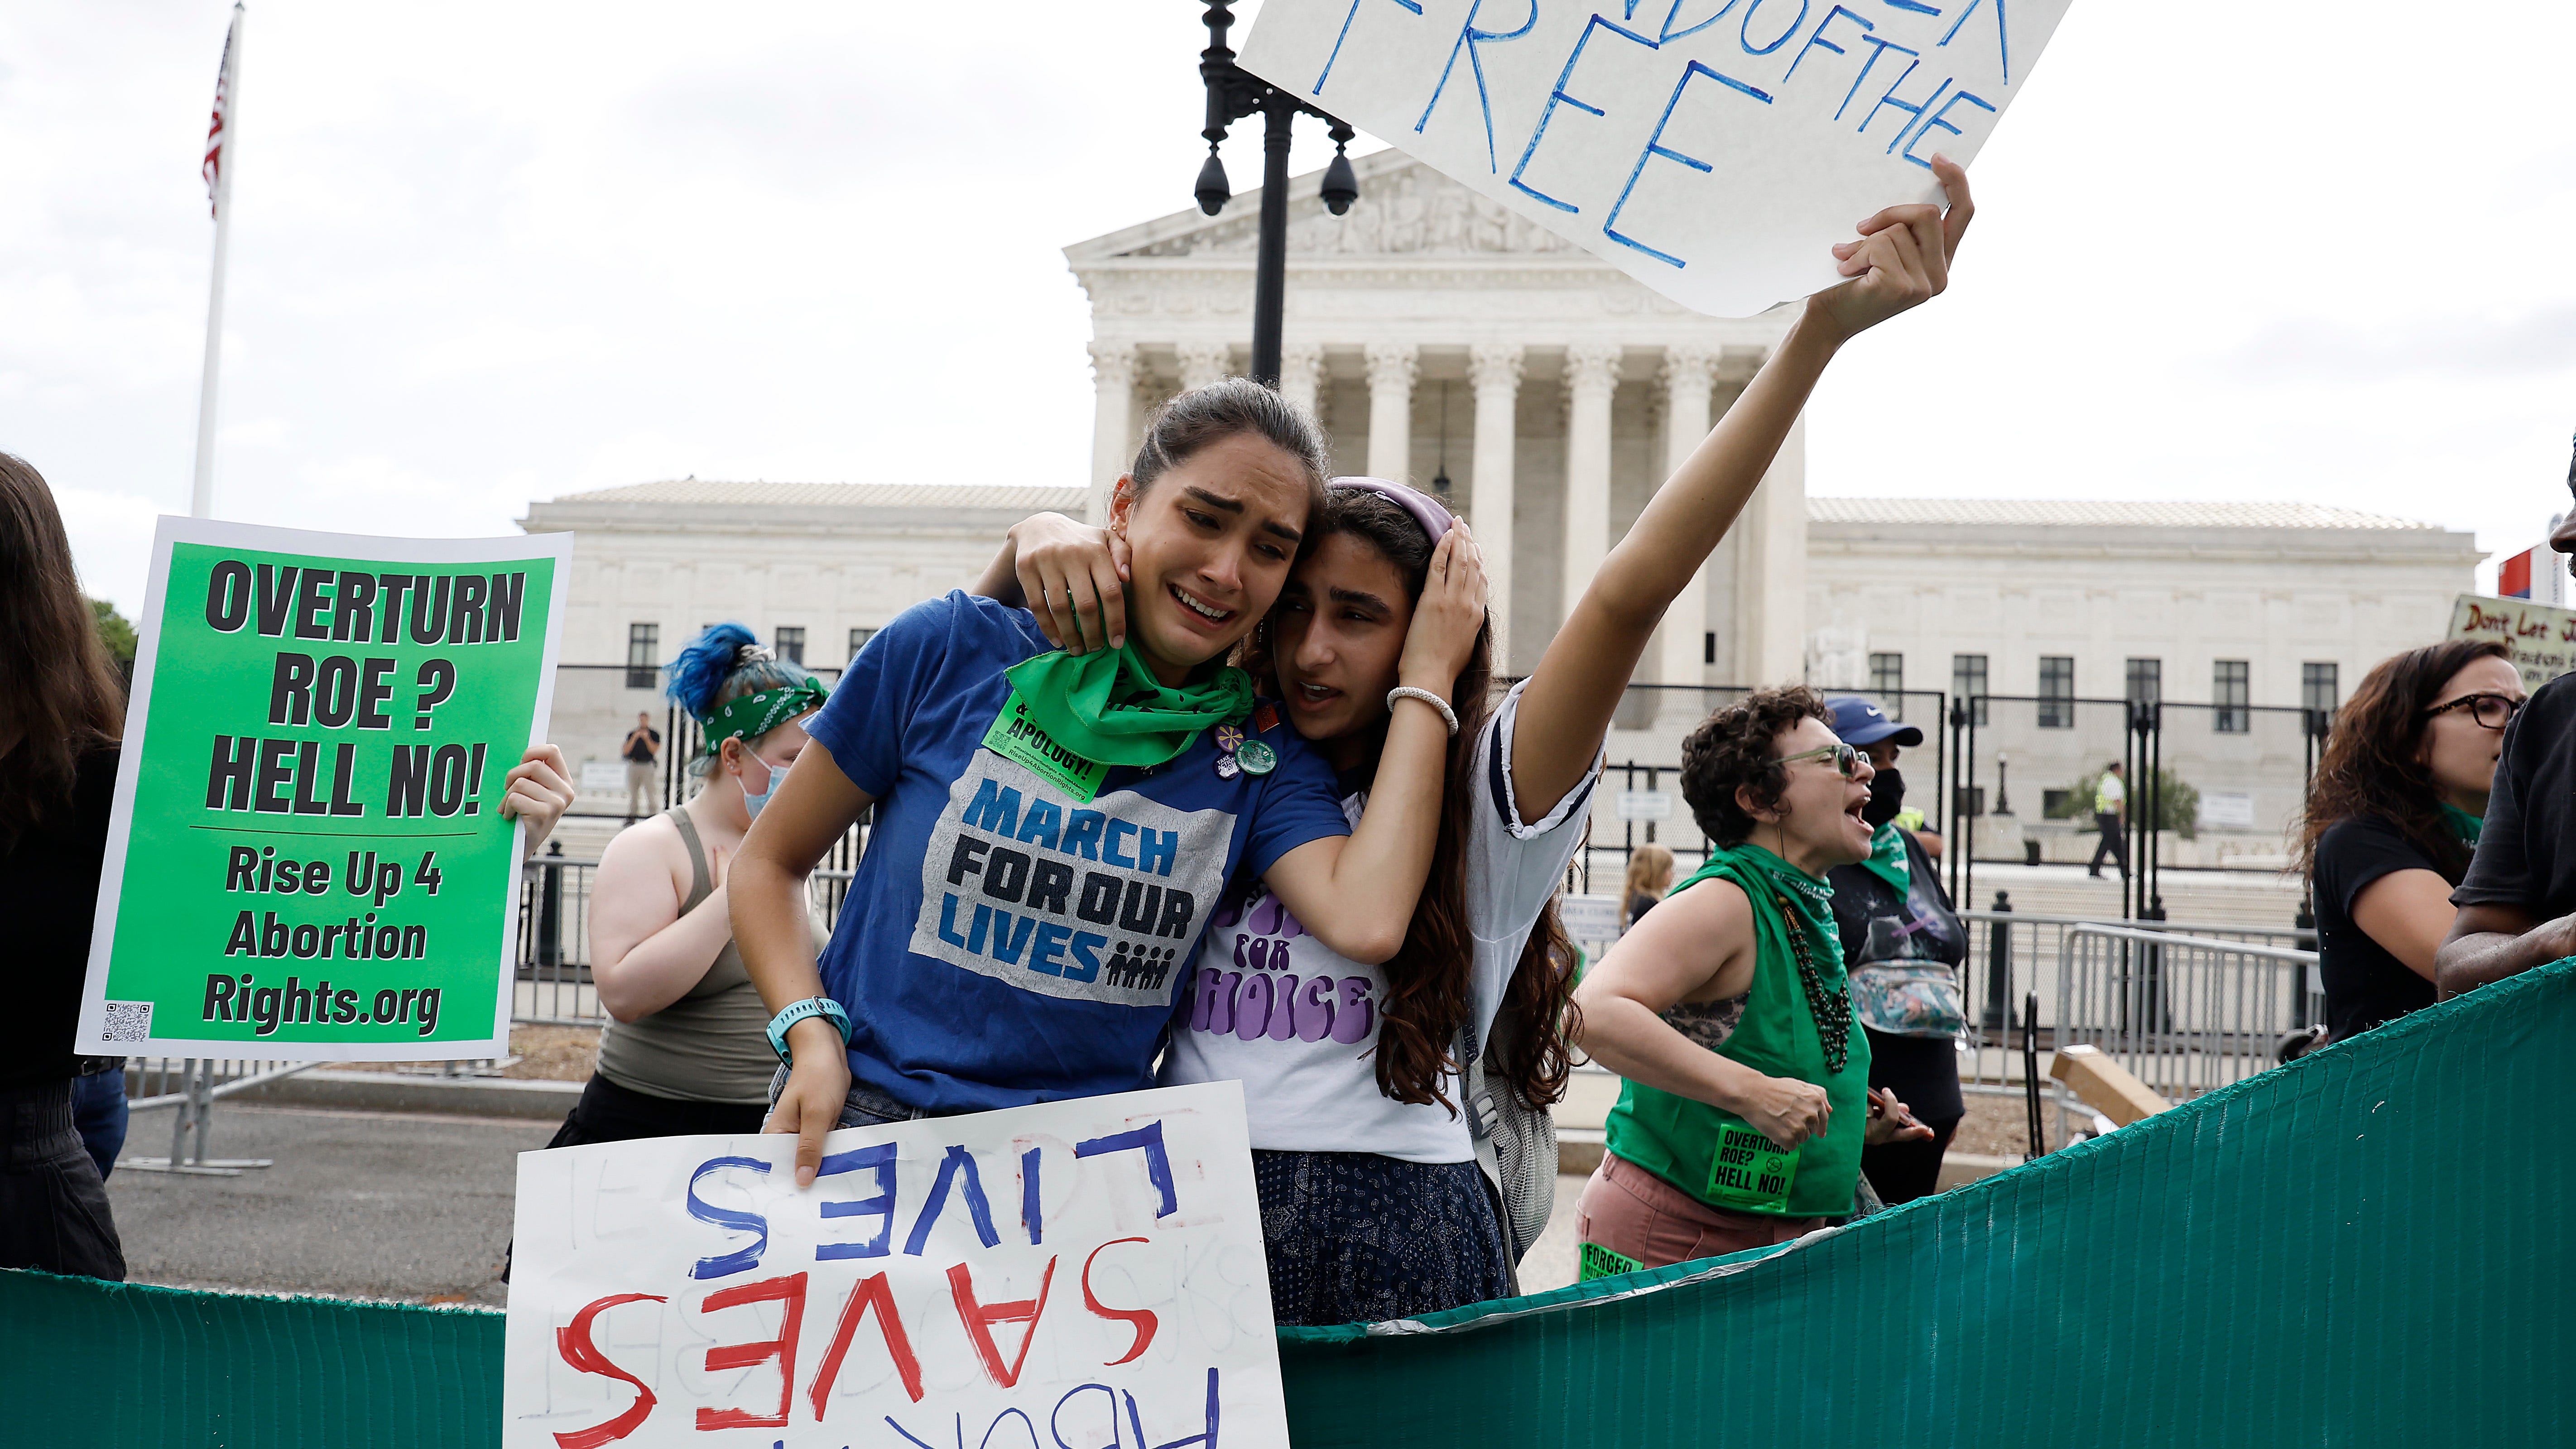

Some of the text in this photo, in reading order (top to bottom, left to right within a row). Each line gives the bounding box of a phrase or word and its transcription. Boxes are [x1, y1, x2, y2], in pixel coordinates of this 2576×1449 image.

[1834, 34, 1996, 170] THE
[205, 560, 525, 645] OVERTURN
[2518, 610, 2547, 638] Let
[268, 652, 456, 730] ROE ?
[205, 734, 488, 818] HELL NO!
[1007, 717, 1095, 781] APOLOGY!
[1009, 749, 1086, 801] RiseUp4AbortionRights.org
[1217, 755, 1230, 765] TAKE
[1218, 757, 1236, 771] ACTION
[1225, 763, 1235, 772] NOT
[962, 778, 1177, 877] MARCH
[226, 846, 442, 907] Rise Up 4
[947, 833, 1074, 915] FOR
[1077, 872, 1195, 939] OUR
[224, 910, 426, 960] Abortion
[938, 892, 1108, 983] LIVES
[1234, 934, 1290, 970] FOR
[202, 974, 442, 1036] Rights.org
[1715, 1165, 1786, 1195] HELL NO!
[1720, 1147, 1754, 1166] ROE?
[687, 1120, 1177, 1280] LIVES
[1586, 1244, 1633, 1275] FORCED
[553, 1237, 1158, 1449] SAVES
